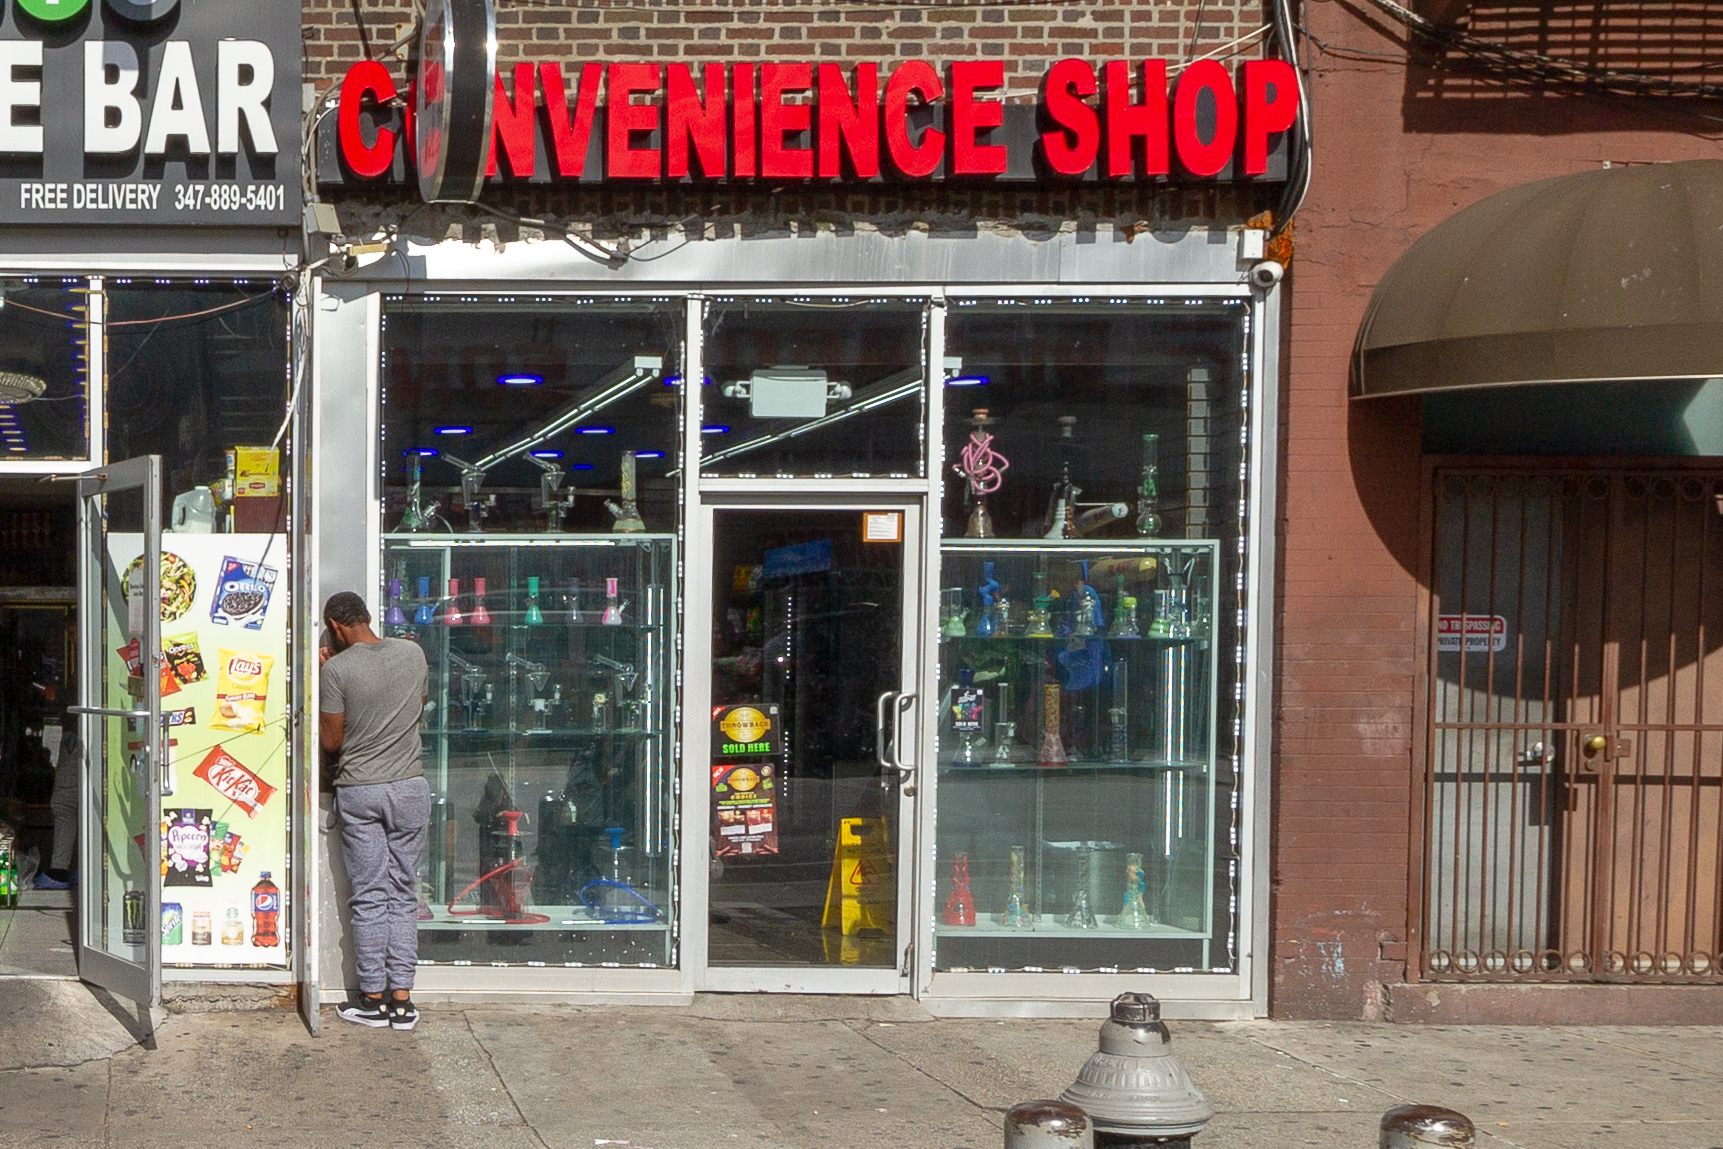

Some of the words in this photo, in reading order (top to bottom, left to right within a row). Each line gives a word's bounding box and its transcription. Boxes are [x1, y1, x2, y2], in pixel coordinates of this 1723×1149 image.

[82, 36, 280, 155] BAR
[338, 59, 1008, 178] CNVENIENCE
[1041, 57, 1299, 178] SHOP
[20, 183, 68, 209] FREE
[73, 183, 161, 210] DELIVERY
[174, 184, 285, 211] 347-889-5401
[1451, 620, 1501, 630] TRSPASSIG
[1465, 636, 1501, 646] PROPETY
[722, 743, 746, 753] SOLD
[747, 742, 770, 753] HERE
[172, 829, 207, 843] Popcorn
